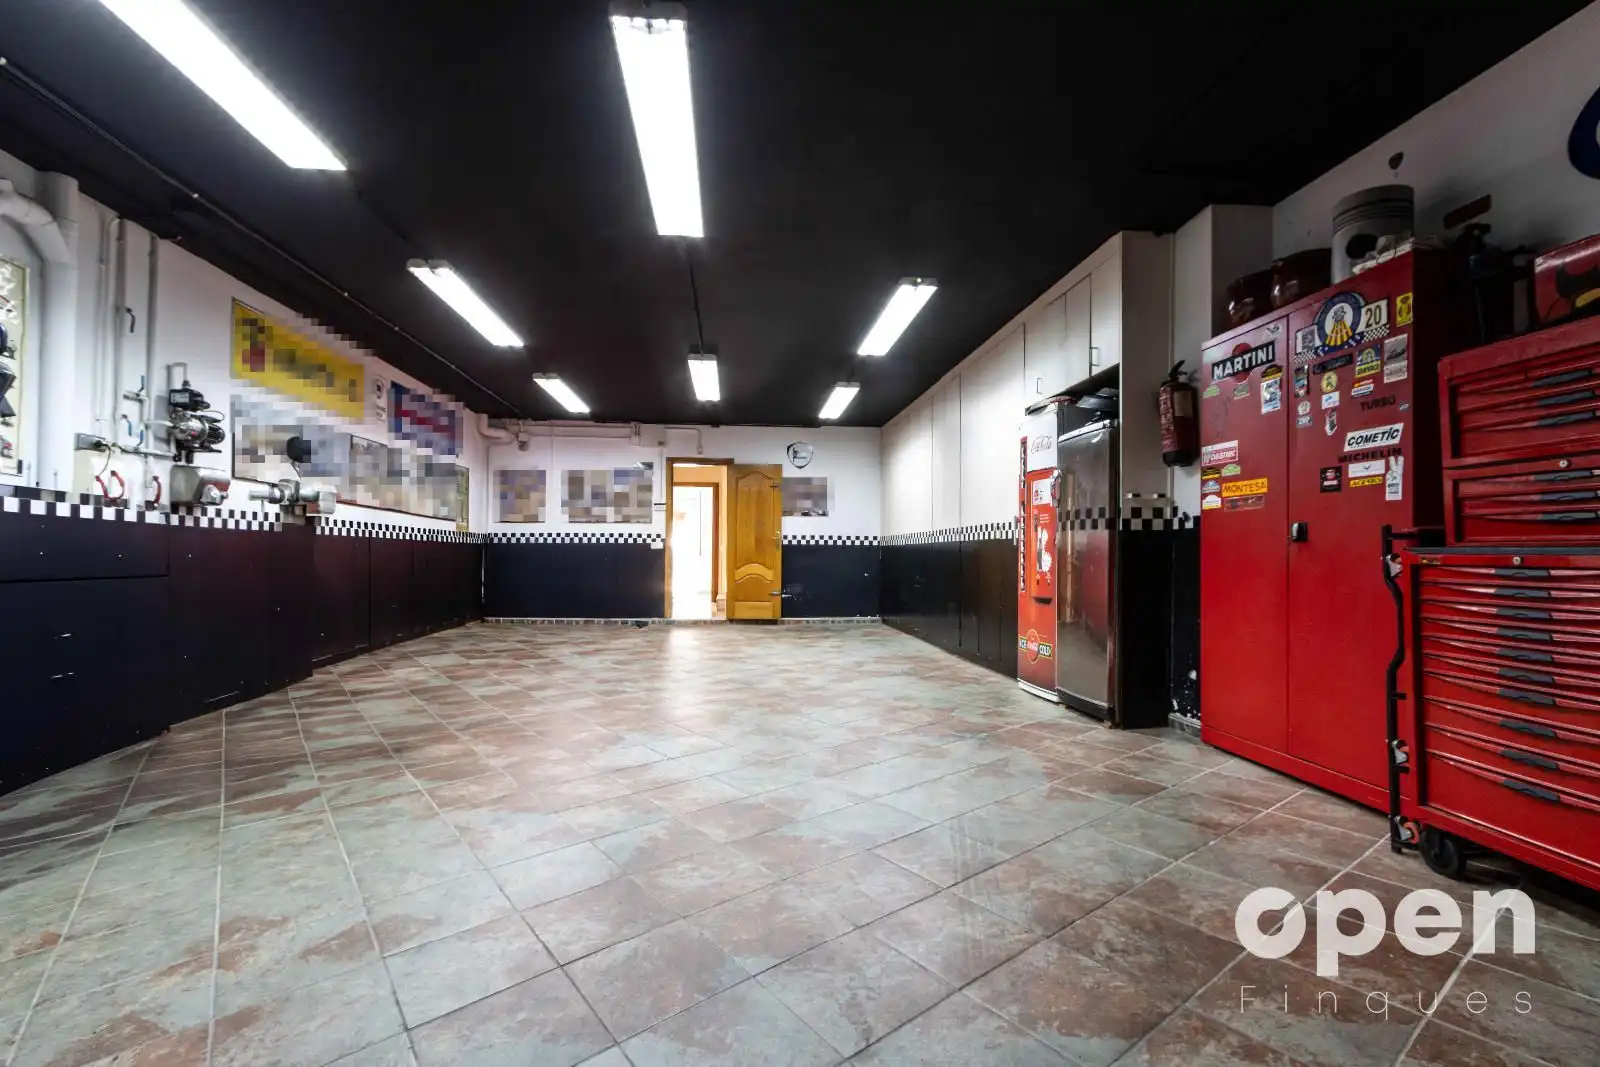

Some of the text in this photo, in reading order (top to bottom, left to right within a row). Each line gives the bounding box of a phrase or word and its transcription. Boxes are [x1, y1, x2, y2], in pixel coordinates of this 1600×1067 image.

[1365, 304, 1382, 328] 20
[1213, 345, 1273, 380] MARTINI
[1360, 395, 1396, 411] TURBO
[1347, 427, 1400, 447] COMETIC
[1338, 448, 1402, 463] MICHELIN
[1223, 481, 1266, 493] MONTESA
